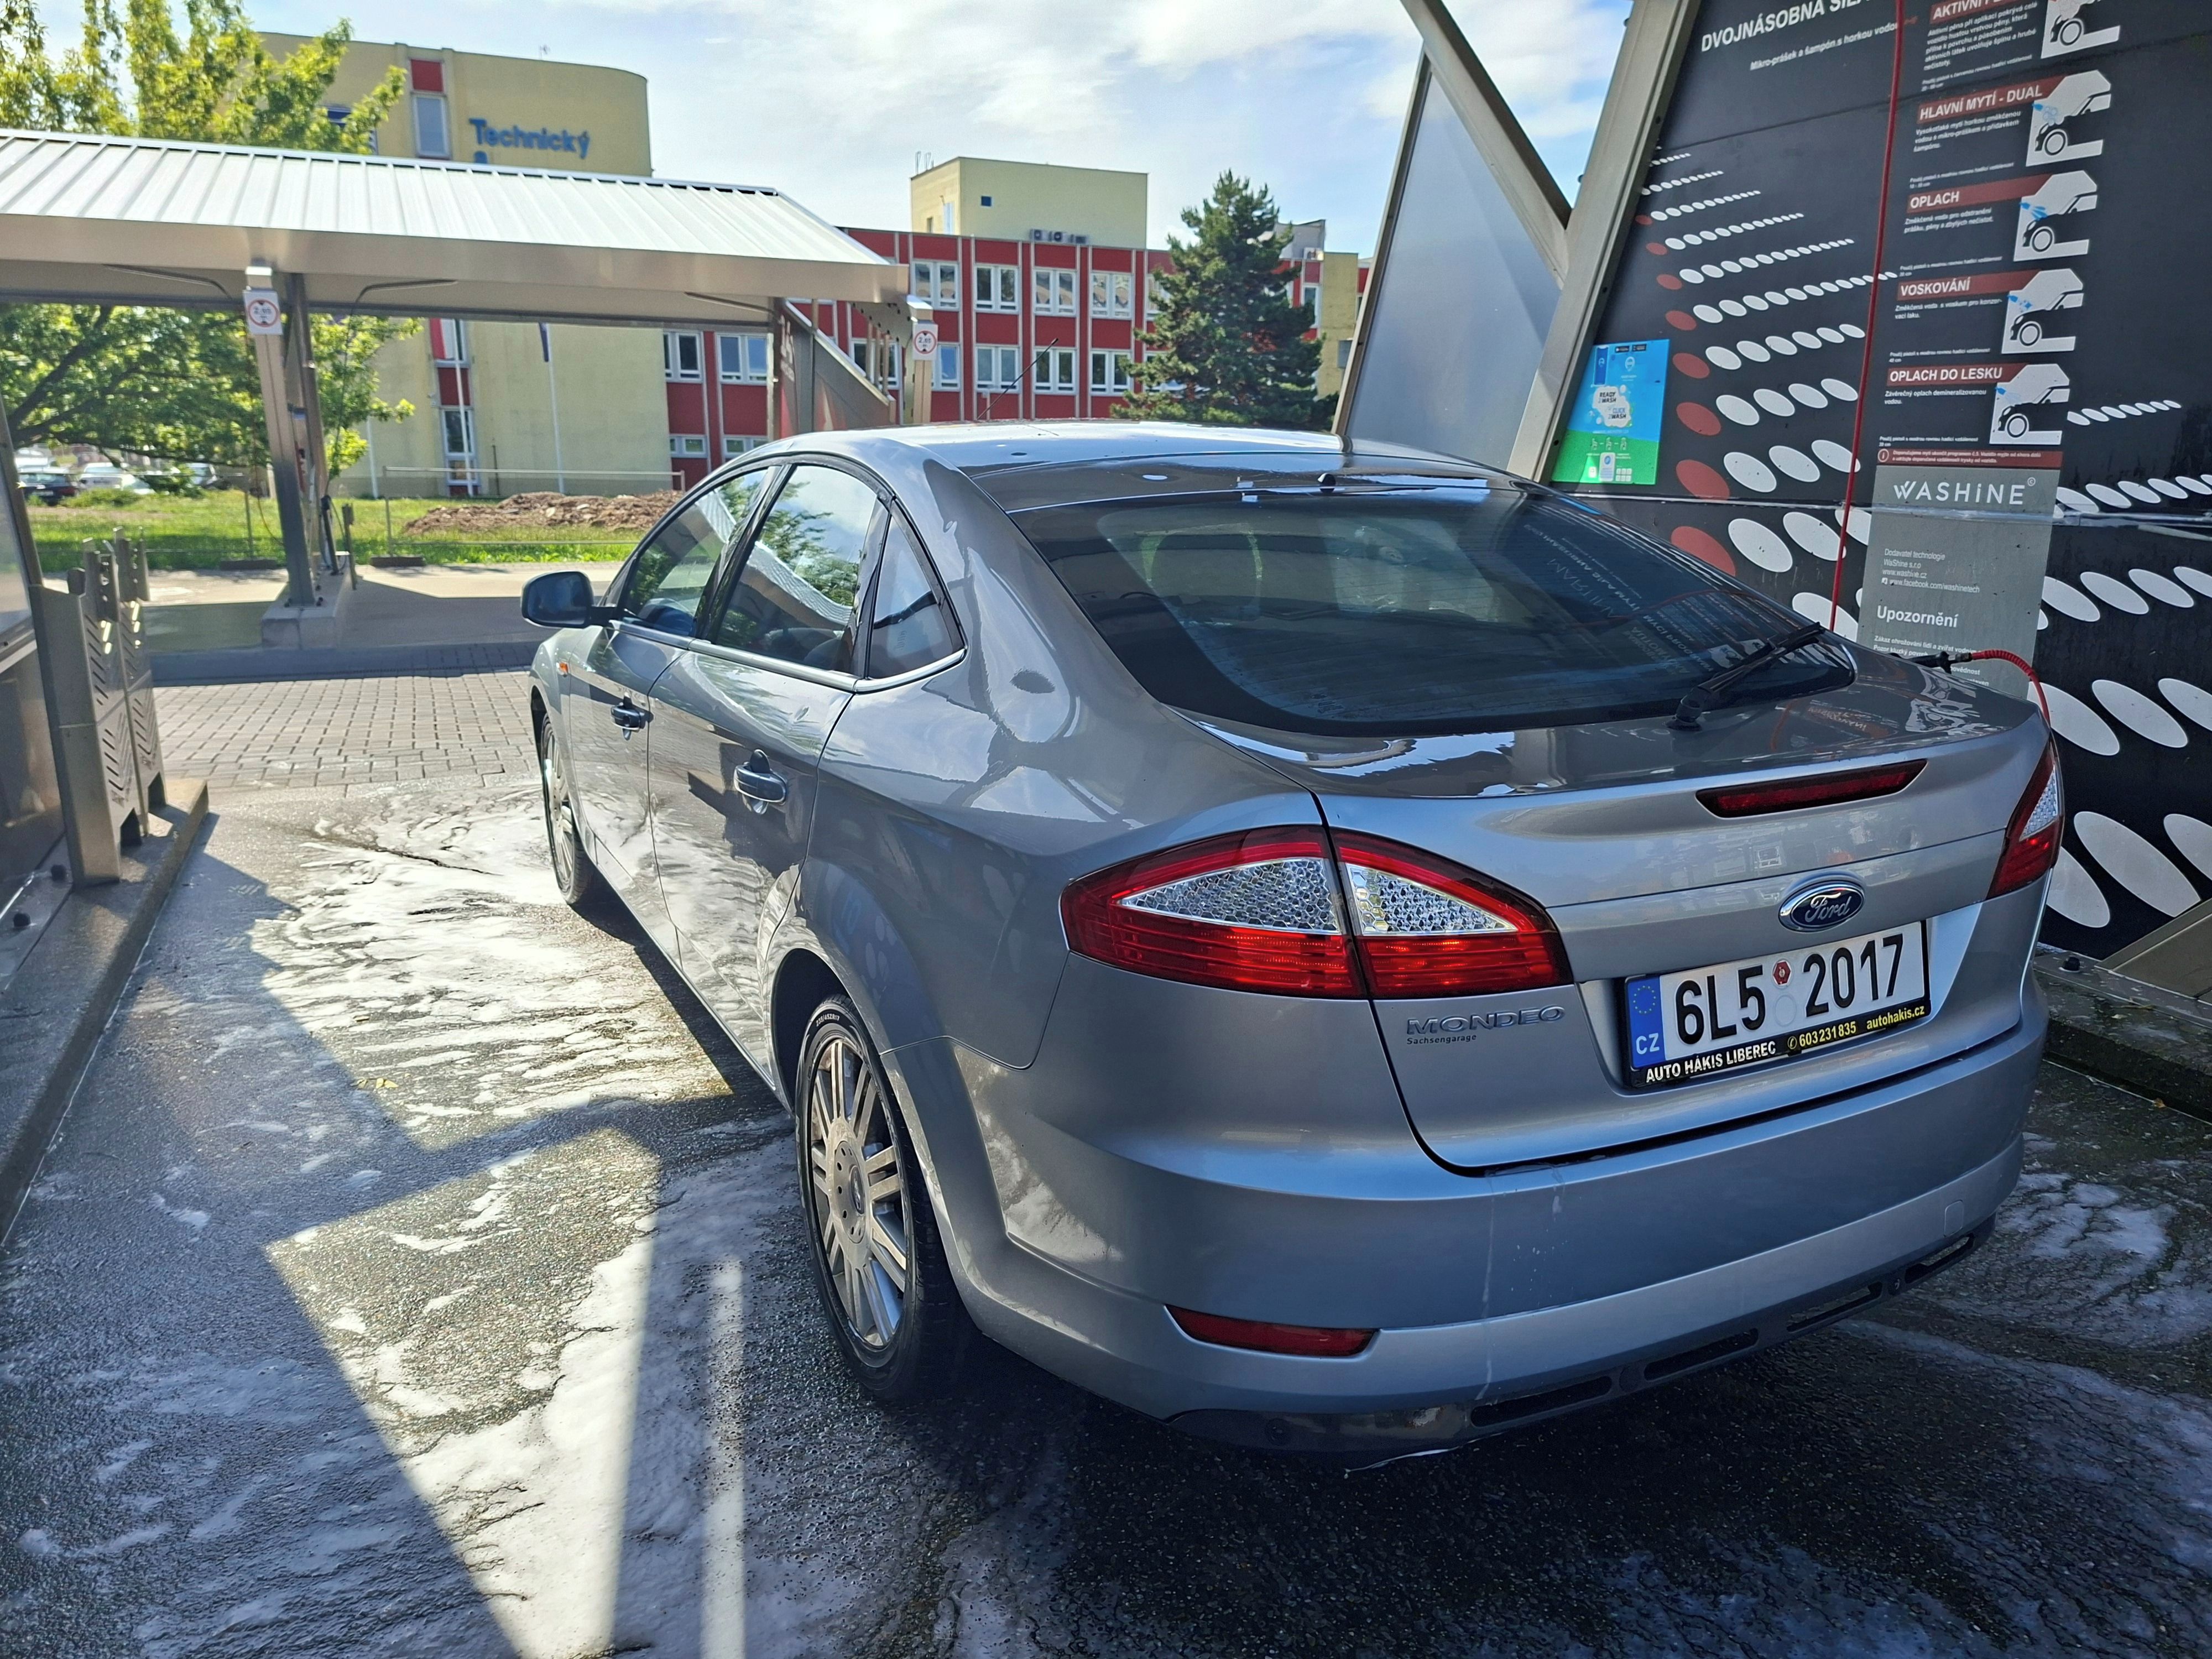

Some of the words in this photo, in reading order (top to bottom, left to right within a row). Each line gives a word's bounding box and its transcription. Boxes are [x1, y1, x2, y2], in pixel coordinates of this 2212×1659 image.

[1844, 29, 1872, 44] horkou
[1919, 98, 1963, 121] HLAVNÍ
[1966, 91, 1996, 111] MYTÍ
[2006, 85, 2043, 102] DUAL
[469, 117, 591, 159] Technický
[1910, 191, 1960, 208] OPLACH
[1901, 276, 1971, 296] VOSKOVÁNÍ
[1890, 368, 1937, 382] OPLACH
[1940, 368, 1958, 380] DO
[1961, 367, 2003, 380] LESKU
[1884, 558, 1908, 567] WaShine
[1885, 548, 1912, 558] Dodavatel
[1913, 550, 1945, 561] technologie
[1882, 569, 1927, 579] www.washine.cz
[1889, 578, 1980, 593] www.facebook.com/washinetech
[1876, 605, 1959, 628] Upozornění
[1874, 635, 1890, 644] Zákaz
[1804, 892, 1852, 922] Ford
[1674, 964, 1766, 1045] 6L5
[1803, 933, 1903, 1018] 2017
[1406, 1005, 1566, 1035] MONDEO
[1406, 1034, 1477, 1045] Sachsengarage
[1635, 1032, 1660, 1055] CZ
[1646, 1062, 1681, 1083] AUTO
[1684, 1053, 1724, 1074] HÁKIS
[1726, 1041, 1776, 1066] LIBEREC
[1866, 1005, 1925, 1030] autohakis.cz
